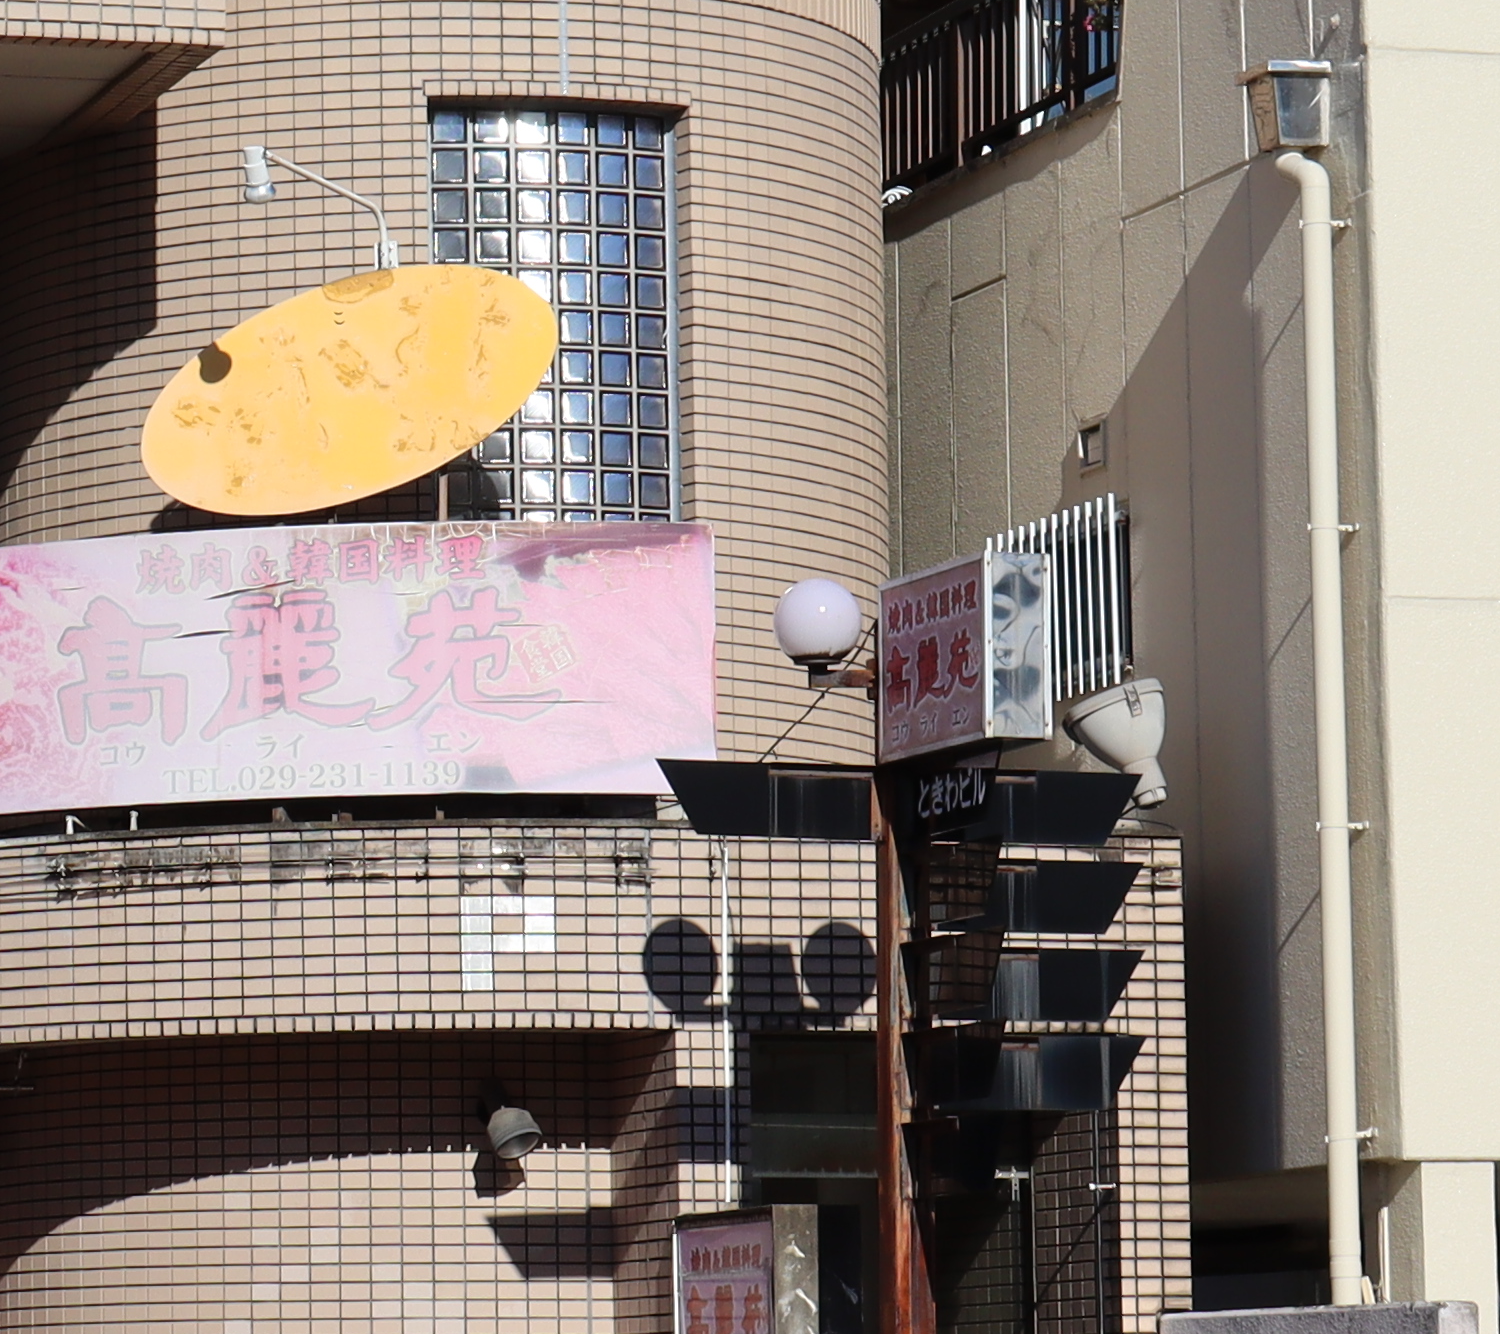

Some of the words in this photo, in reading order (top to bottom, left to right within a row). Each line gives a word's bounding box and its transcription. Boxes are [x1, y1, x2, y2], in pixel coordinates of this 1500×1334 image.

[892, 720, 909, 743] コウ
[919, 712, 938, 736] ライ
[952, 706, 970, 727] エン
[101, 740, 146, 767] コウ
[255, 734, 304, 760] ライ
[427, 732, 481, 754] エン
[162, 761, 462, 796] TEL.029-231-1139
[918, 768, 986, 819] ときわビル
